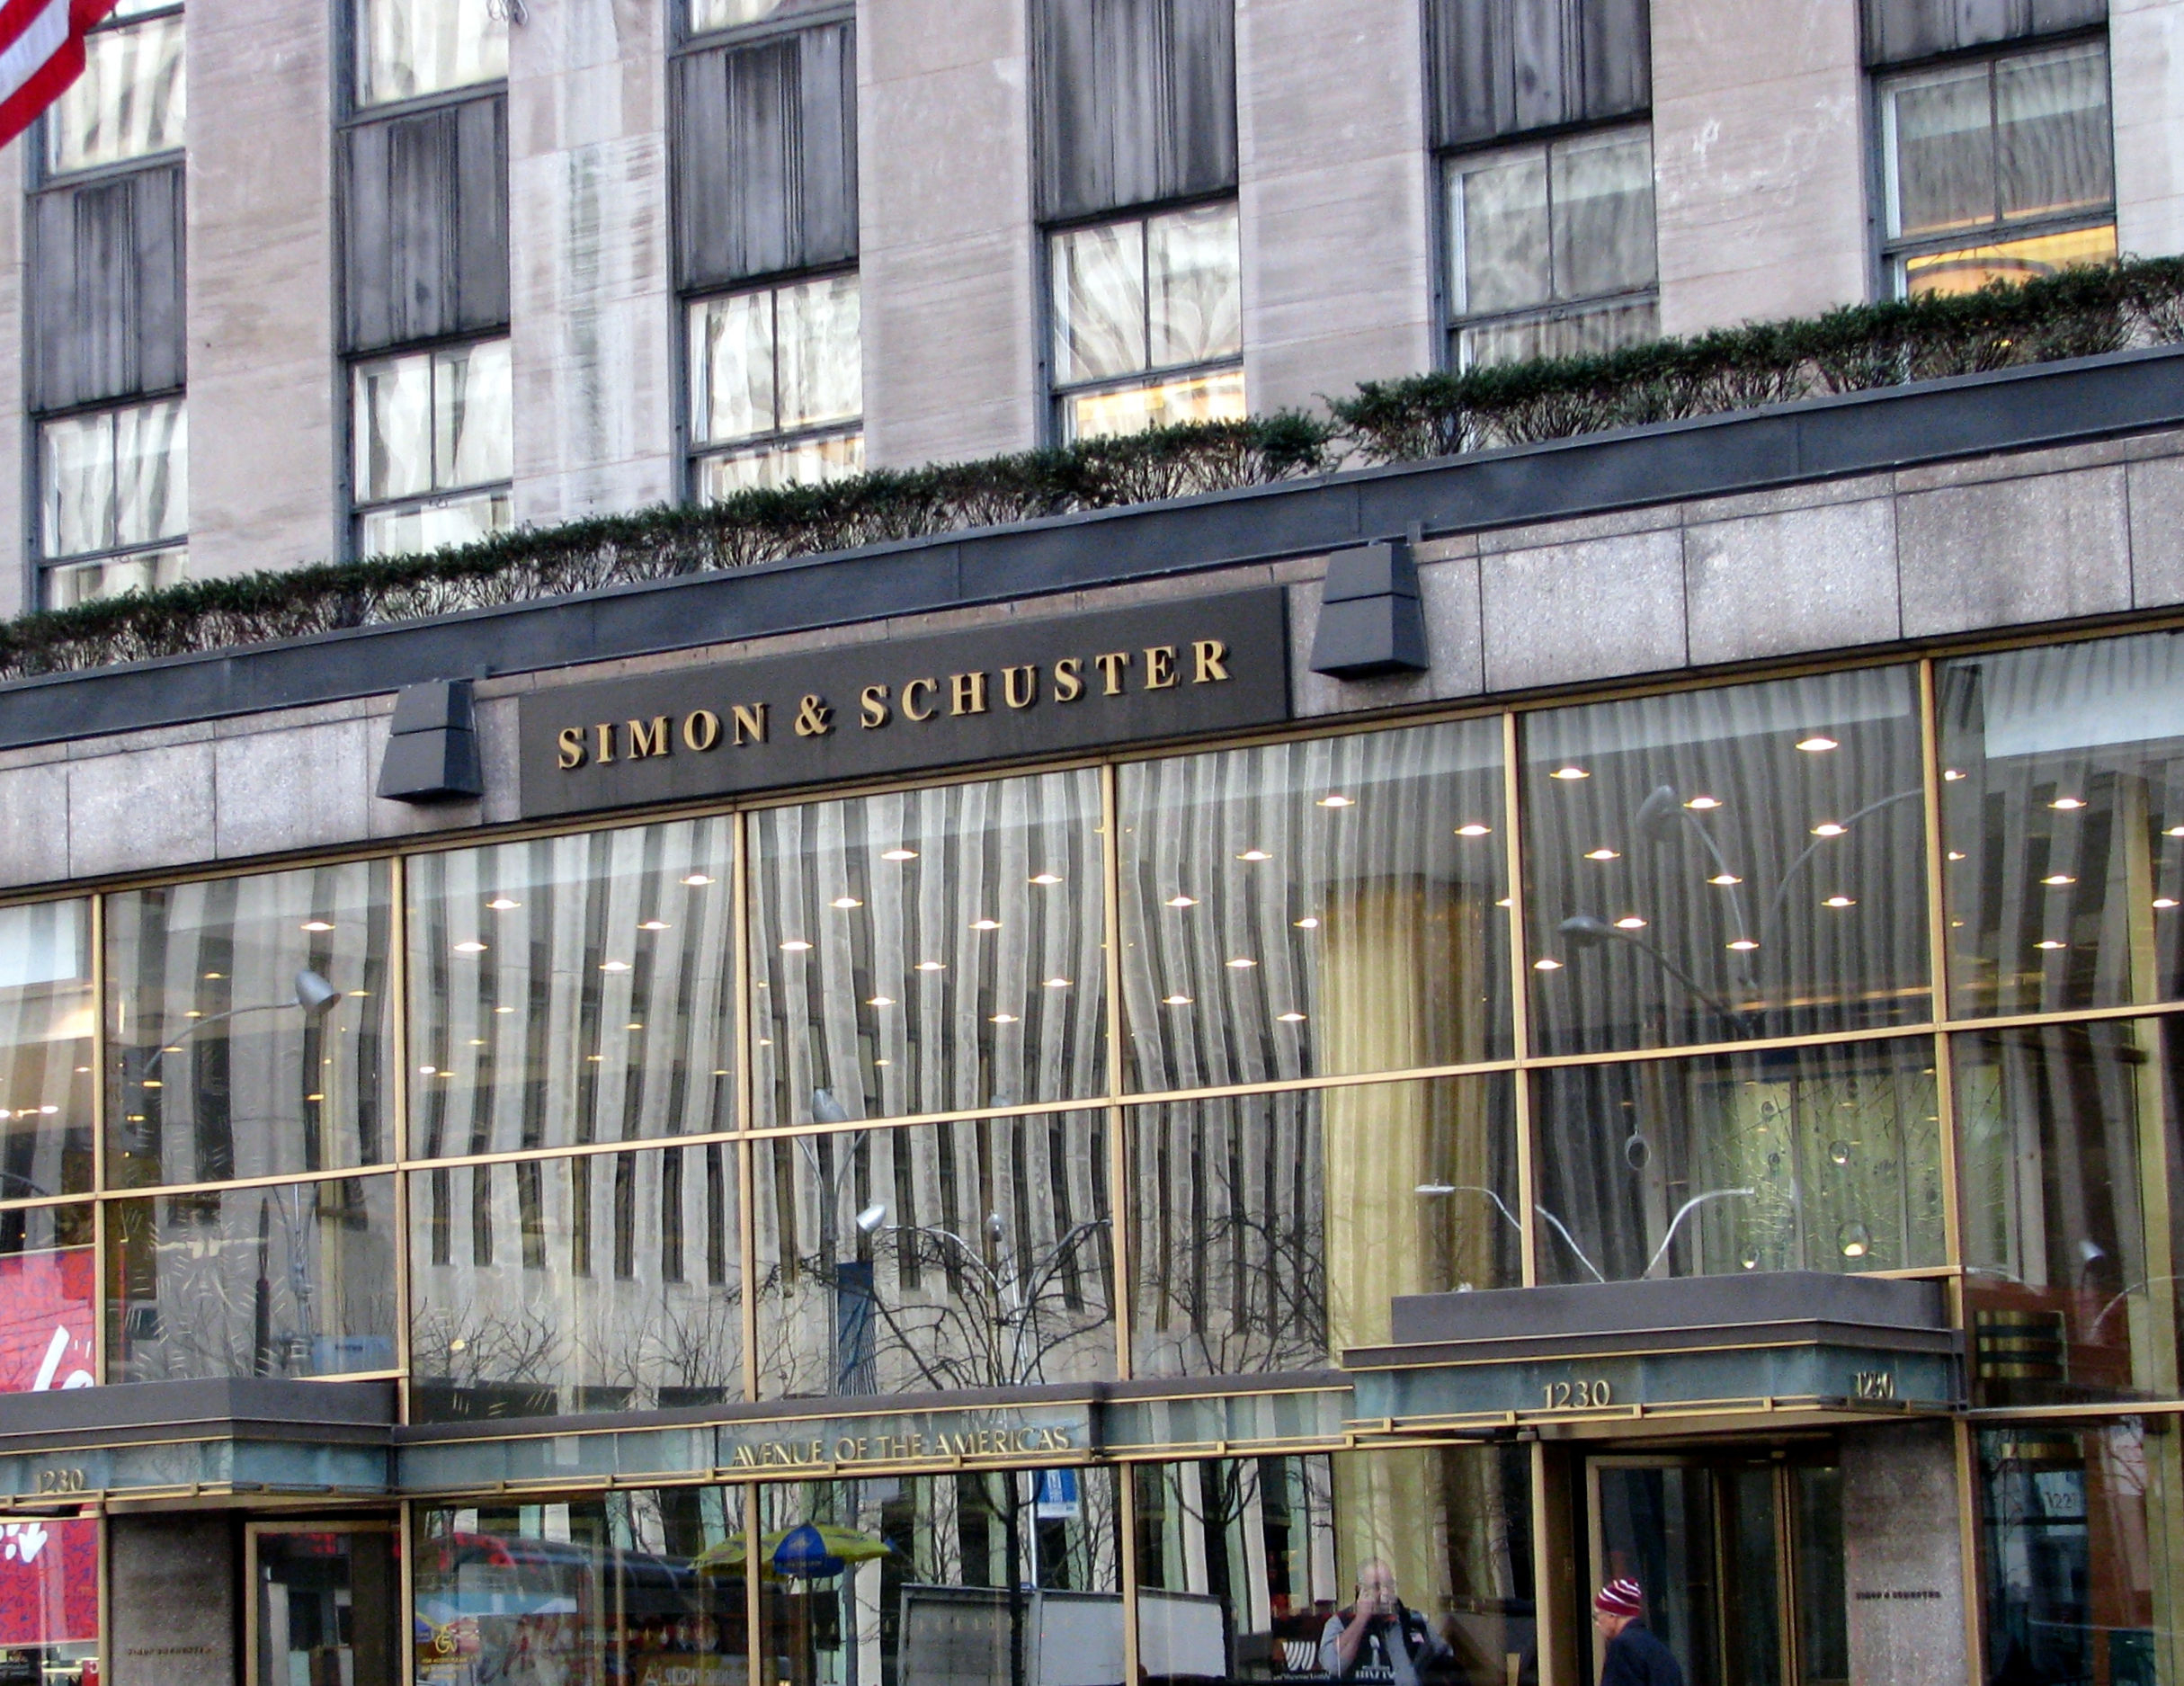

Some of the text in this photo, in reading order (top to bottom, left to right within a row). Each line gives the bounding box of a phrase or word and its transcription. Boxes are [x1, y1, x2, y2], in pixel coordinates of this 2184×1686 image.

[557, 638, 1232, 771] SIMON & SCHUSTER
[1543, 1379, 1611, 1409] 1230
[732, 1425, 1071, 1467] AVENUE OF THE AMERICAS
[35, 1467, 85, 1494] 1230
